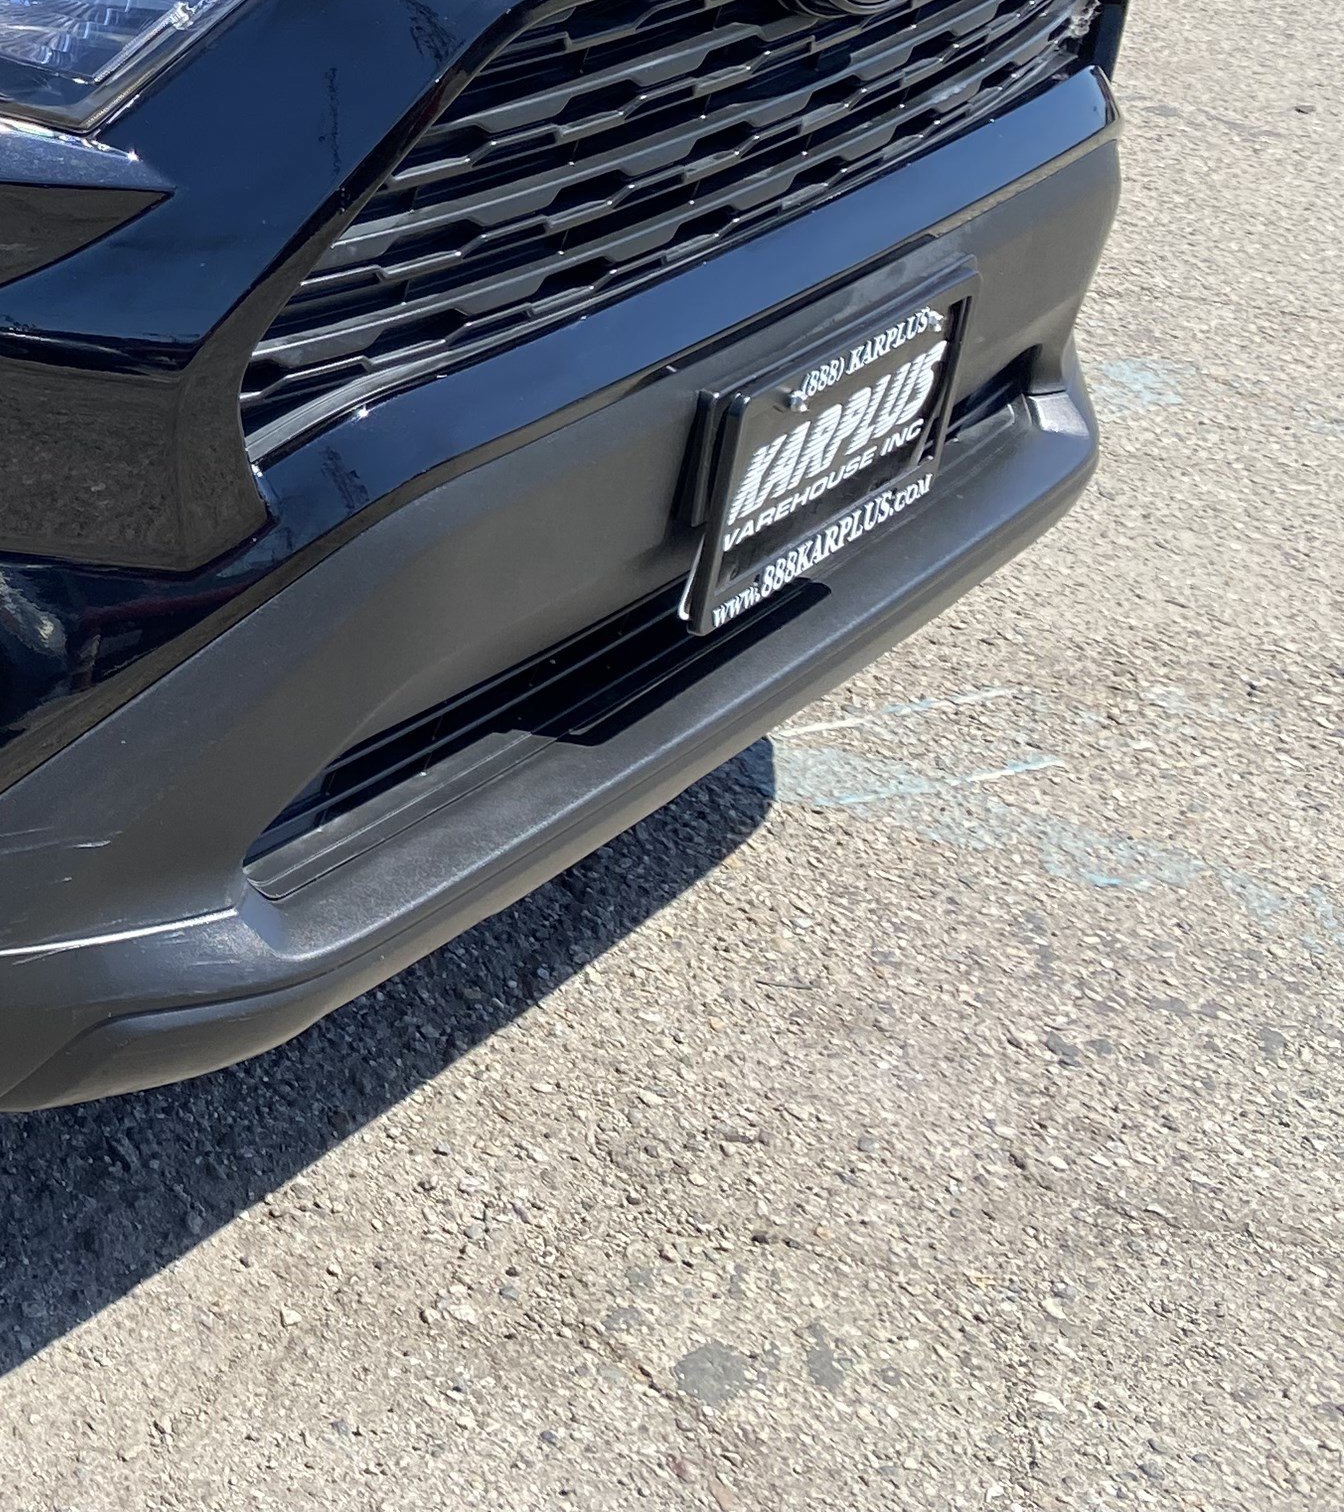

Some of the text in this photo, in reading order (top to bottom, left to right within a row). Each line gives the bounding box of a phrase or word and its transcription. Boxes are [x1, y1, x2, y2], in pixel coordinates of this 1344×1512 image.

[799, 306, 930, 398] (888) KARPLUS
[728, 340, 948, 526] KARPLUS
